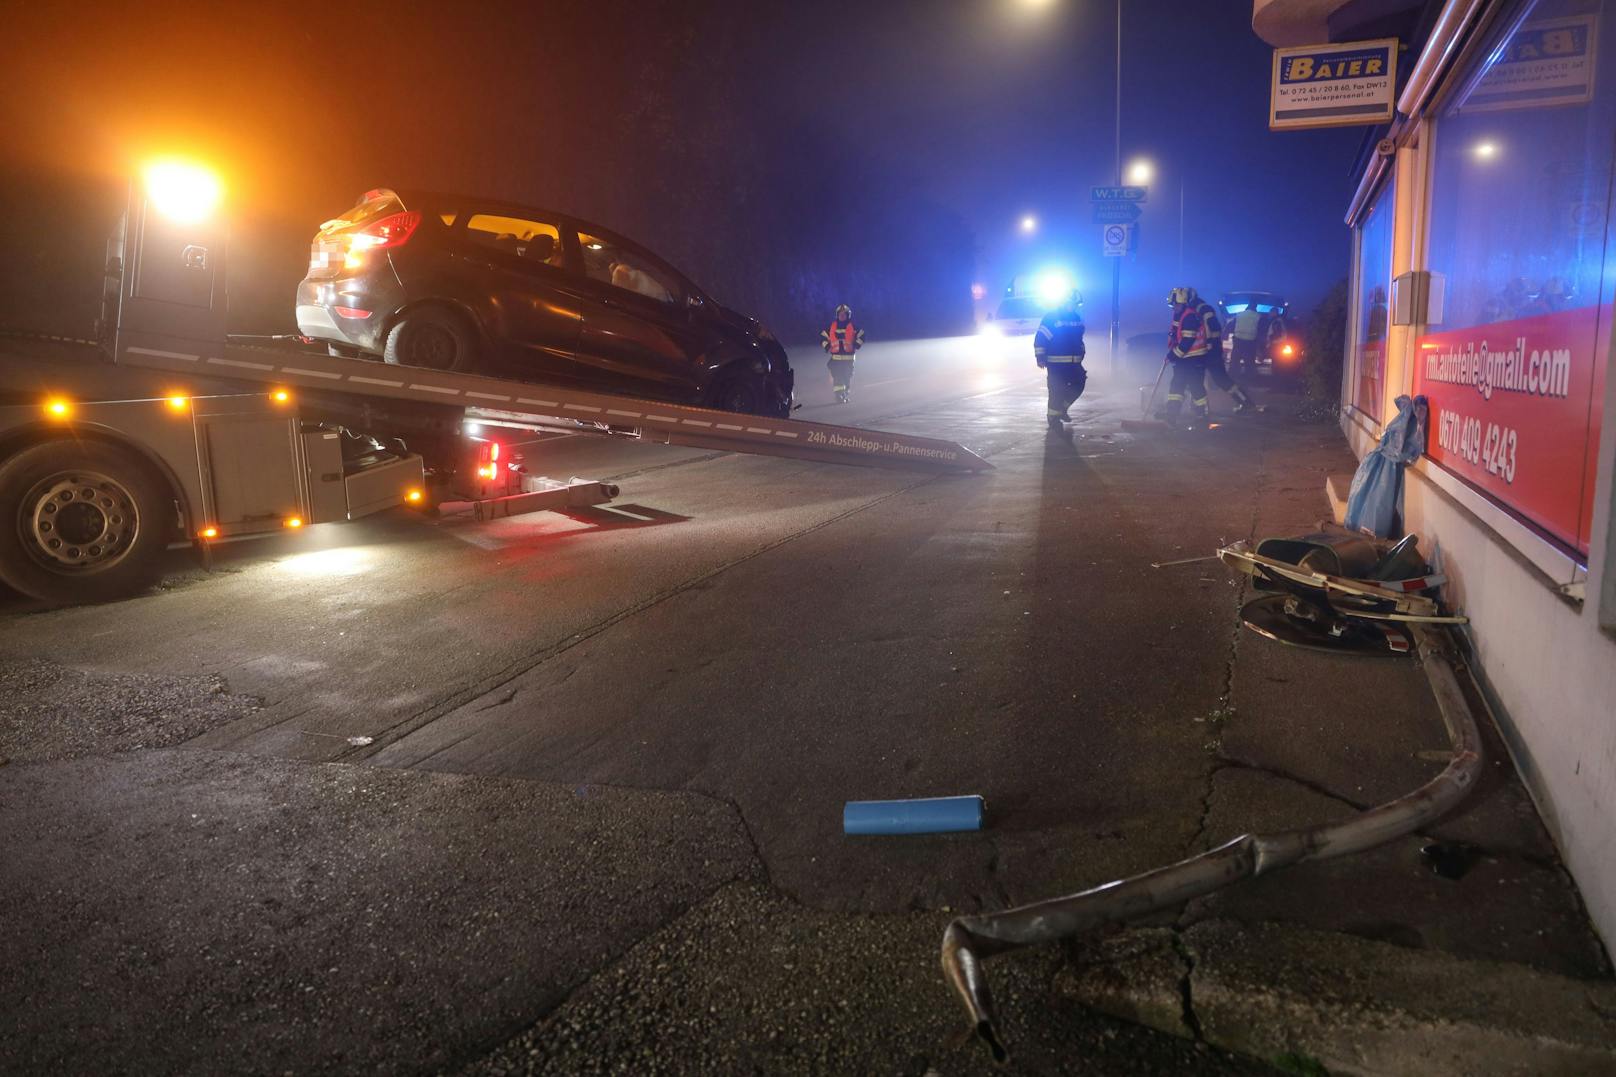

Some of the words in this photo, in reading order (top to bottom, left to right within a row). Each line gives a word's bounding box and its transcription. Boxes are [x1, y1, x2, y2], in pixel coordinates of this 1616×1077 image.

[1288, 56, 1383, 81] BAIER
[807, 430, 827, 444] 24h
[1460, 415, 1481, 465] 409
[1482, 421, 1518, 483] 4243
